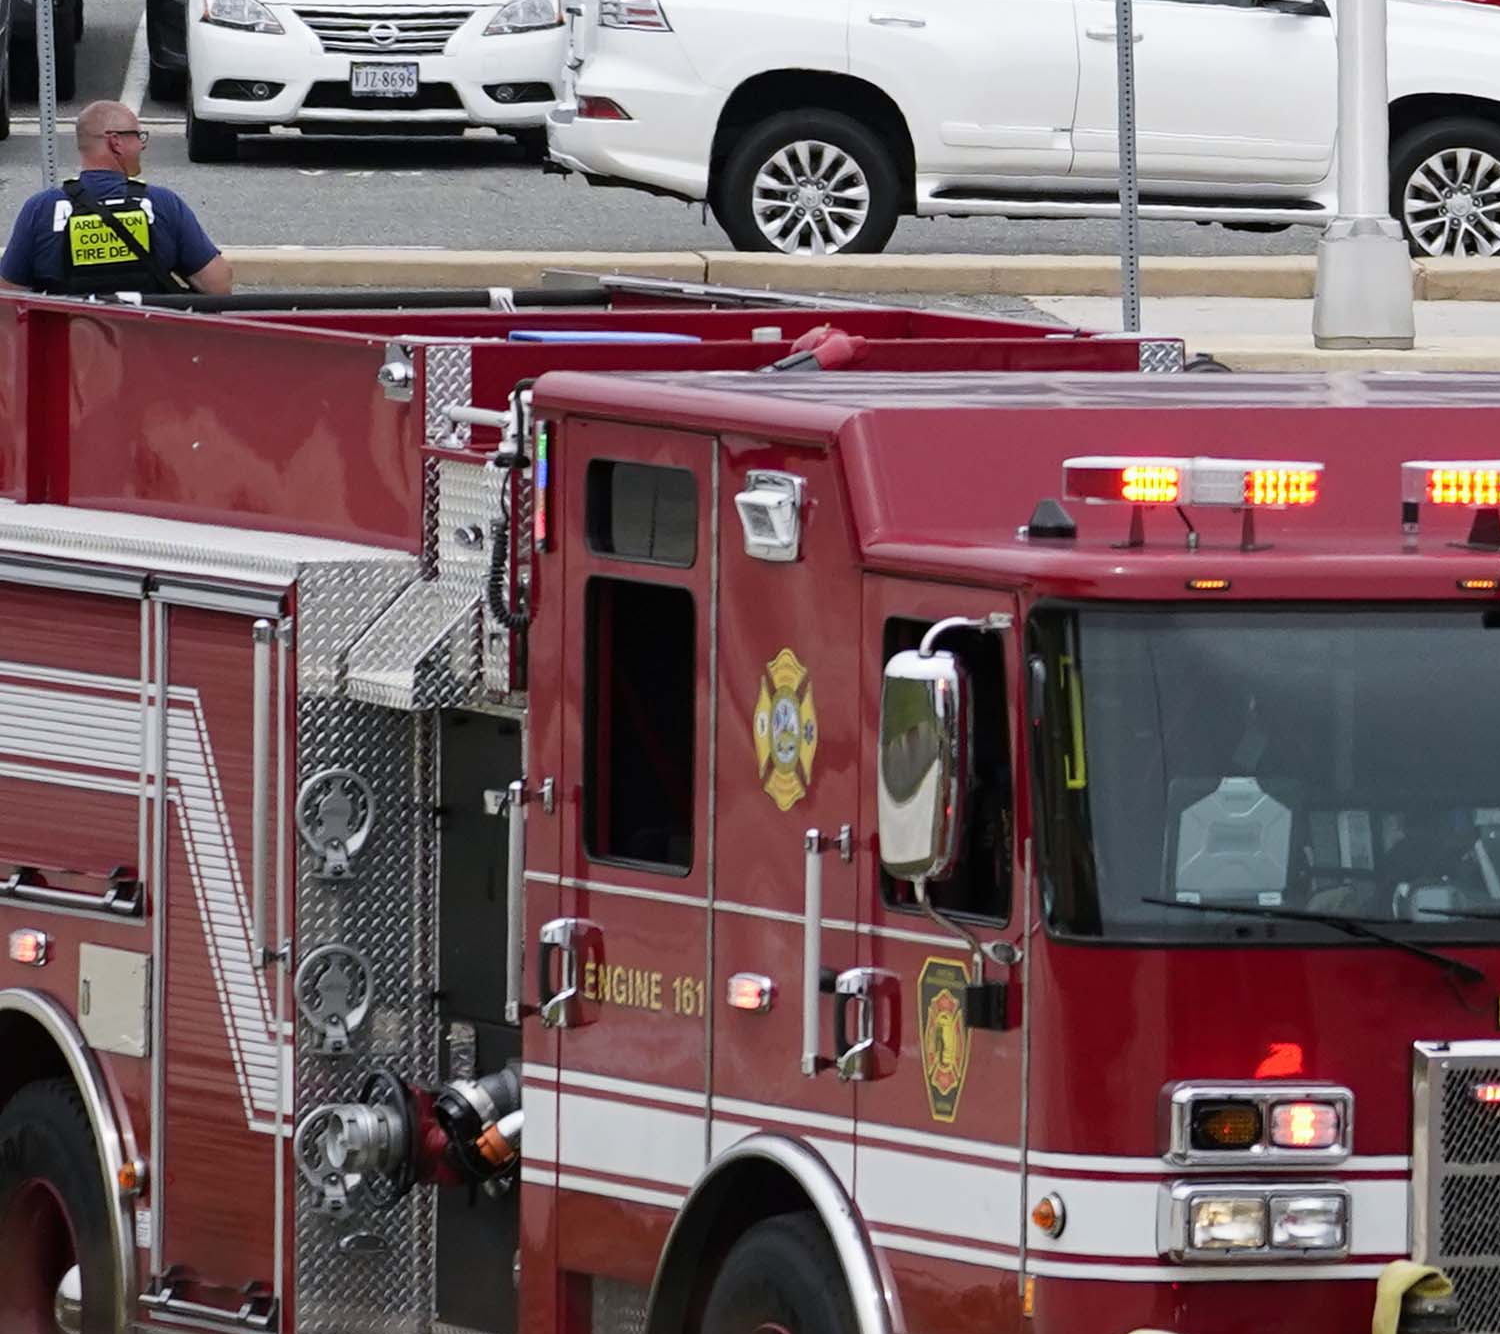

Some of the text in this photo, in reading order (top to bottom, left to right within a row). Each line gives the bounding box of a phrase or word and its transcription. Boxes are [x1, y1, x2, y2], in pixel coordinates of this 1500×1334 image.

[75, 246, 107, 260] FIRE
[583, 961, 705, 1017] ENGINE 161
